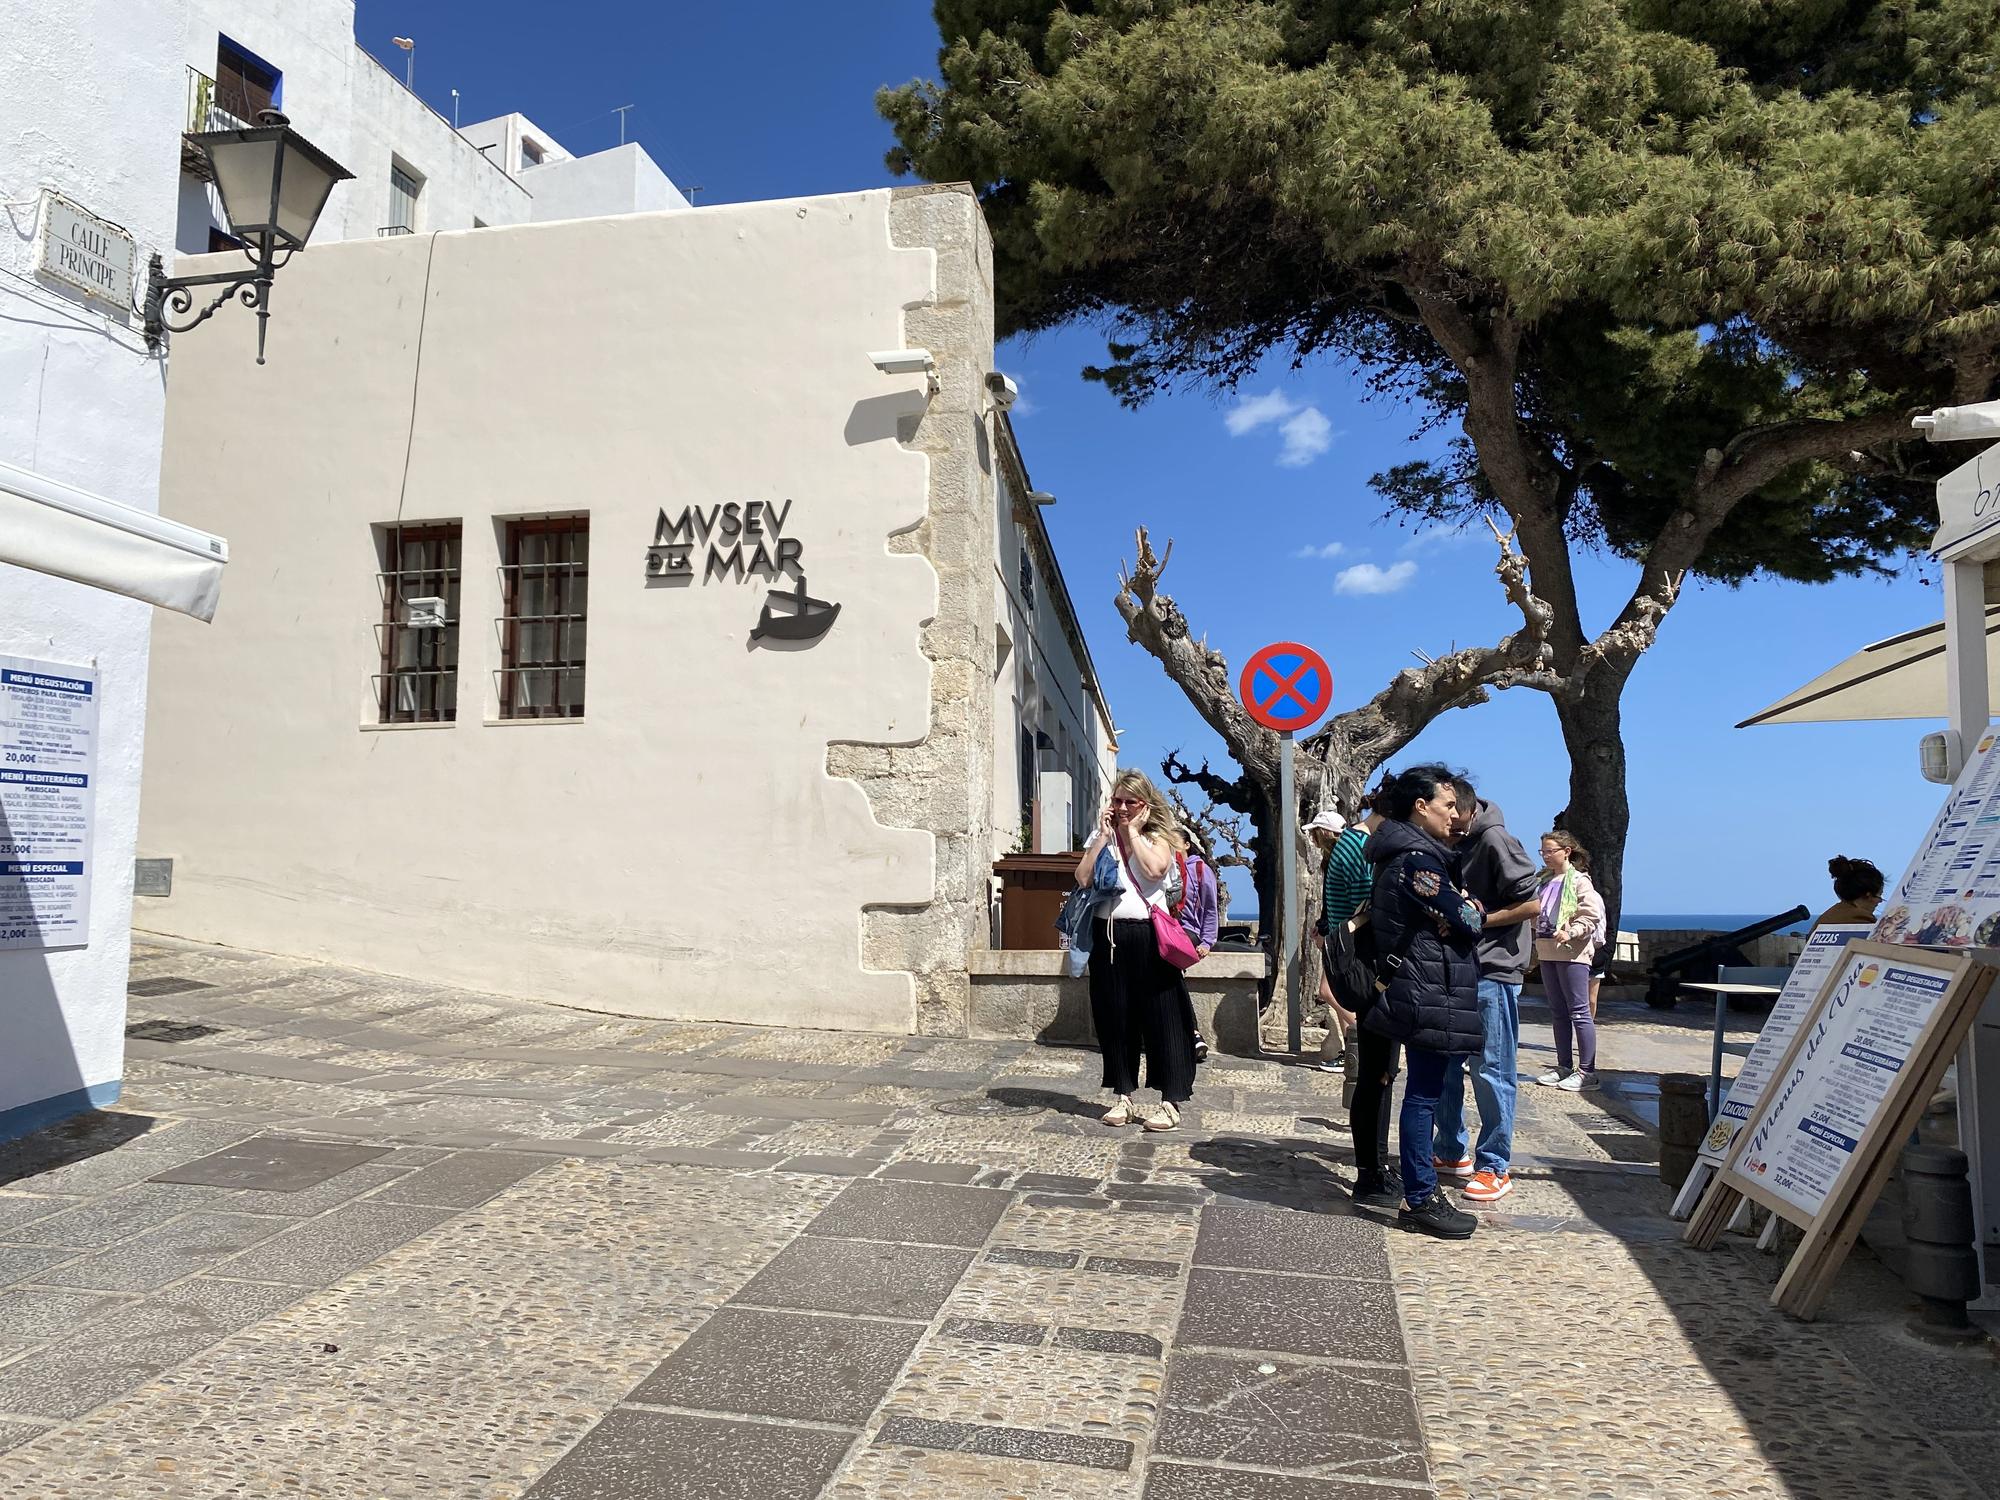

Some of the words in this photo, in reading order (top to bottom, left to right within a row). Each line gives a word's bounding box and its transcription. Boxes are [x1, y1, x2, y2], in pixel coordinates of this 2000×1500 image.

[71, 222, 111, 259] CALLE
[60, 243, 116, 290] PRINCIPE
[655, 498, 792, 541] MVSEV
[705, 537, 805, 576] MAR
[10, 673, 33, 684] MENÚ
[34, 677, 85, 691] DEGUSTACIÓN
[7, 686, 40, 696] PRIMEROS
[40, 690, 57, 698] PARA
[5, 752, 36, 764] 20,00€
[0, 772, 24, 781] MENÚ
[25, 774, 83, 785] MEDITERRÁNEO
[0, 844, 31, 855] 25,00€
[8, 863, 31, 872] MENÚ
[32, 864, 68, 872] ESPECIAL
[1, 929, 26, 940] 2,00€
[1812, 933, 1840, 944] PIZZAS
[1906, 975, 1945, 989] DEGUSTACIÓN
[1807, 1022, 1828, 1061] del
[1854, 1034, 1876, 1047] 20,00€
[1860, 1051, 1900, 1069] MEDITERRÁNEO
[1723, 1101, 1753, 1118] RACIONE
[1810, 1110, 1831, 1125] 25,00€
[1808, 1124, 1824, 1135] MENÚ
[1823, 1130, 1847, 1146] ESPECIAL
[1810, 1138, 1833, 1151] MARISCADA
[1773, 1174, 1794, 1190] 32,00€
